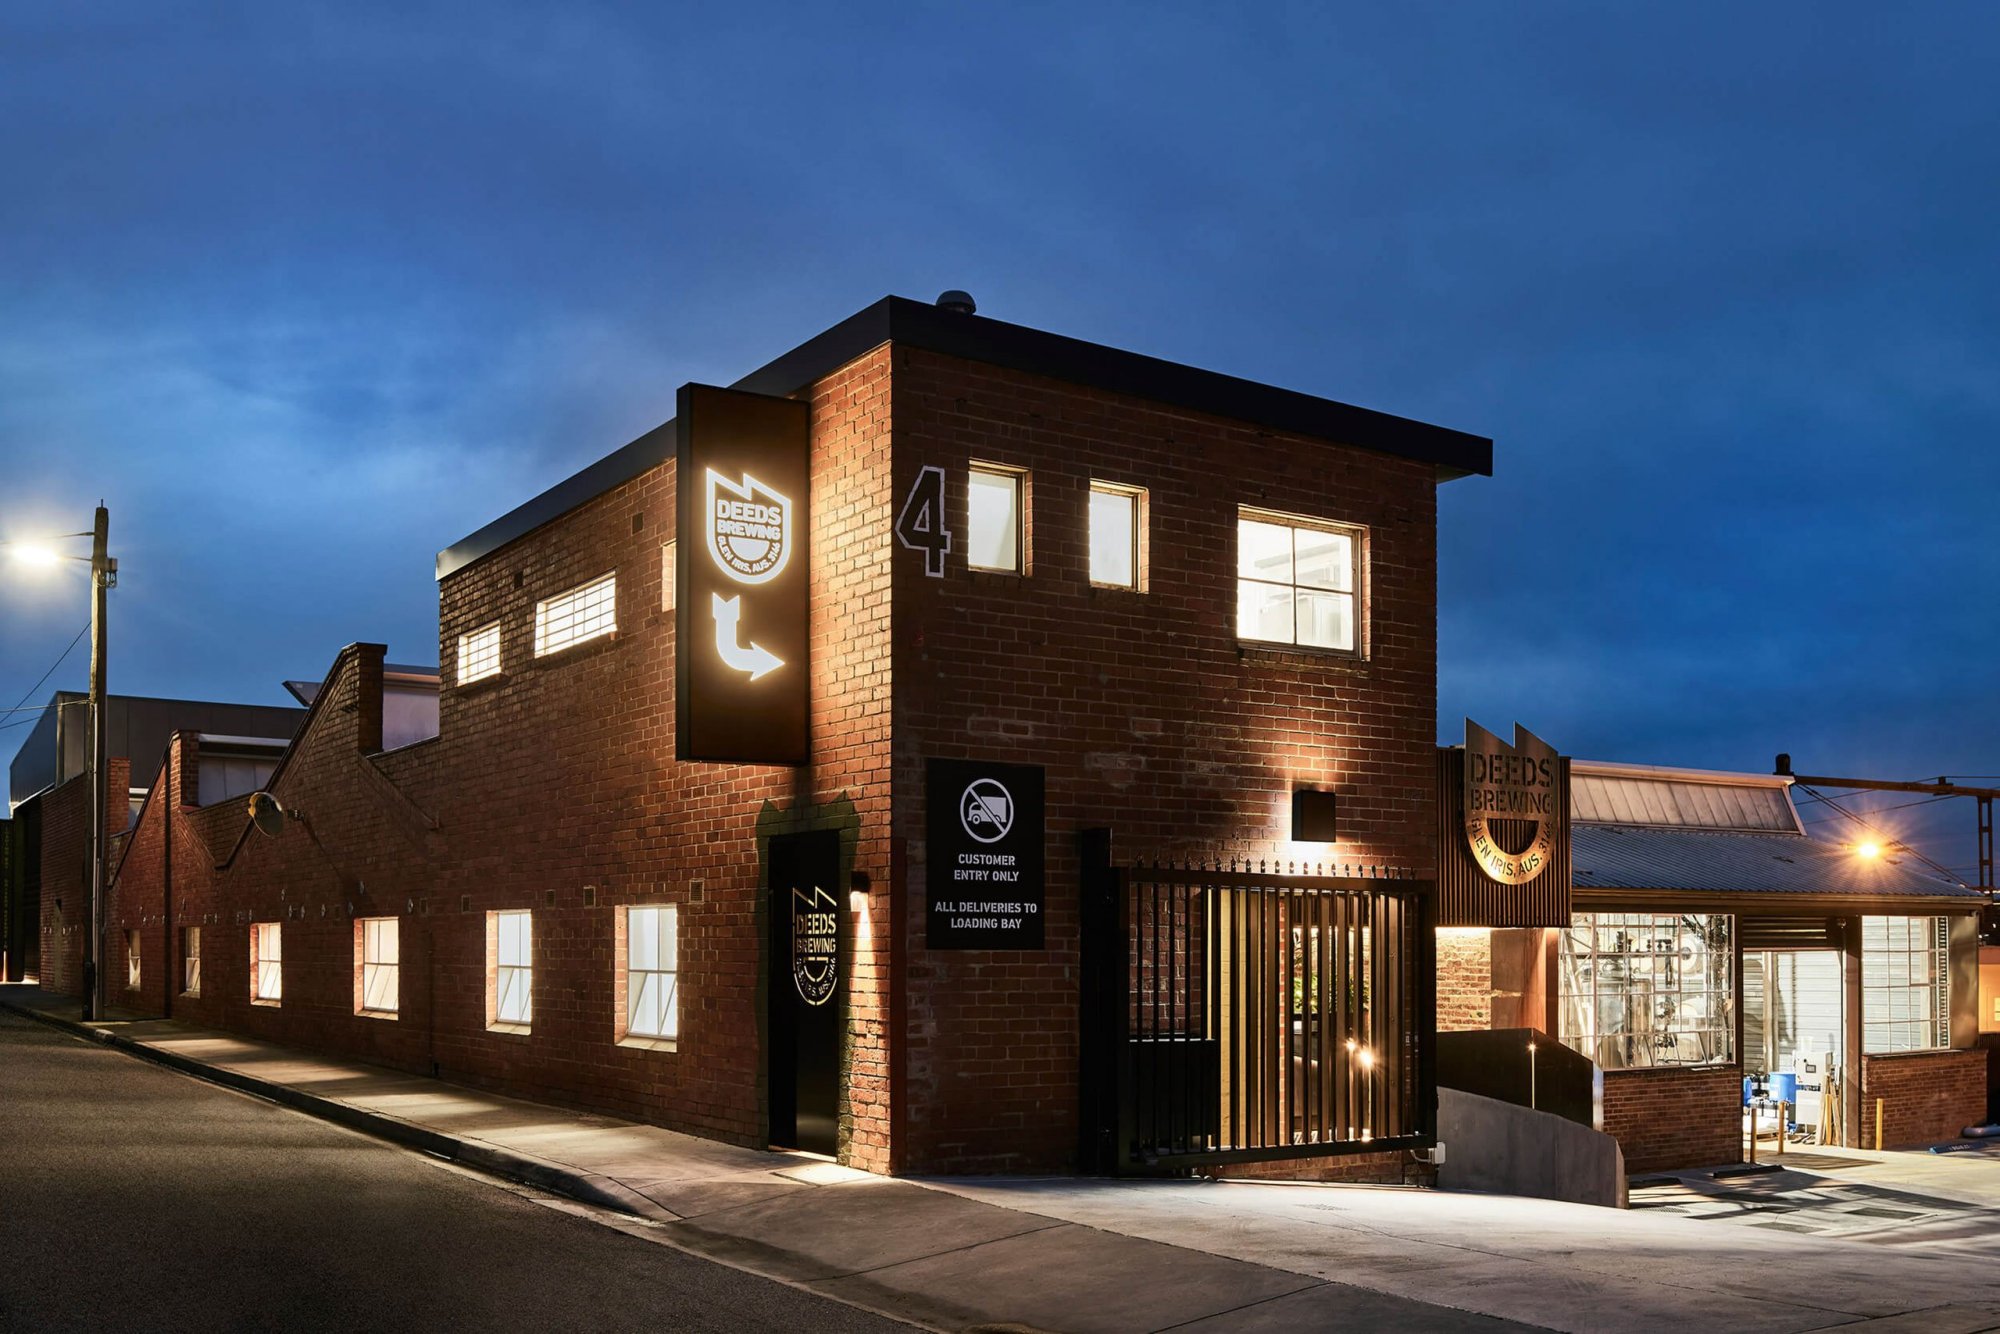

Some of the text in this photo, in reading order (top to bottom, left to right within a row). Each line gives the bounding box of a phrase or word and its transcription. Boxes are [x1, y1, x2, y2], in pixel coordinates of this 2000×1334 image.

[717, 499, 781, 526] DEEDS
[894, 465, 952, 578] 4
[717, 519, 781, 541] BREWING
[718, 535, 733, 561] GLEN
[1470, 753, 1554, 788] DEEDS
[1470, 789, 1554, 815] BREWING
[1471, 817, 1491, 859] GLEN
[1490, 855, 1517, 878] IRIS,
[1519, 853, 1543, 875] AUS.
[958, 853, 1016, 866] CUSTOMER
[954, 869, 1020, 882] ENTRY ONLY
[935, 901, 1037, 914] ALL DELIVERIES TO
[796, 913, 837, 935] DEEDS
[951, 917, 1022, 929] LOADING BAY
[796, 937, 837, 954] BREWING
